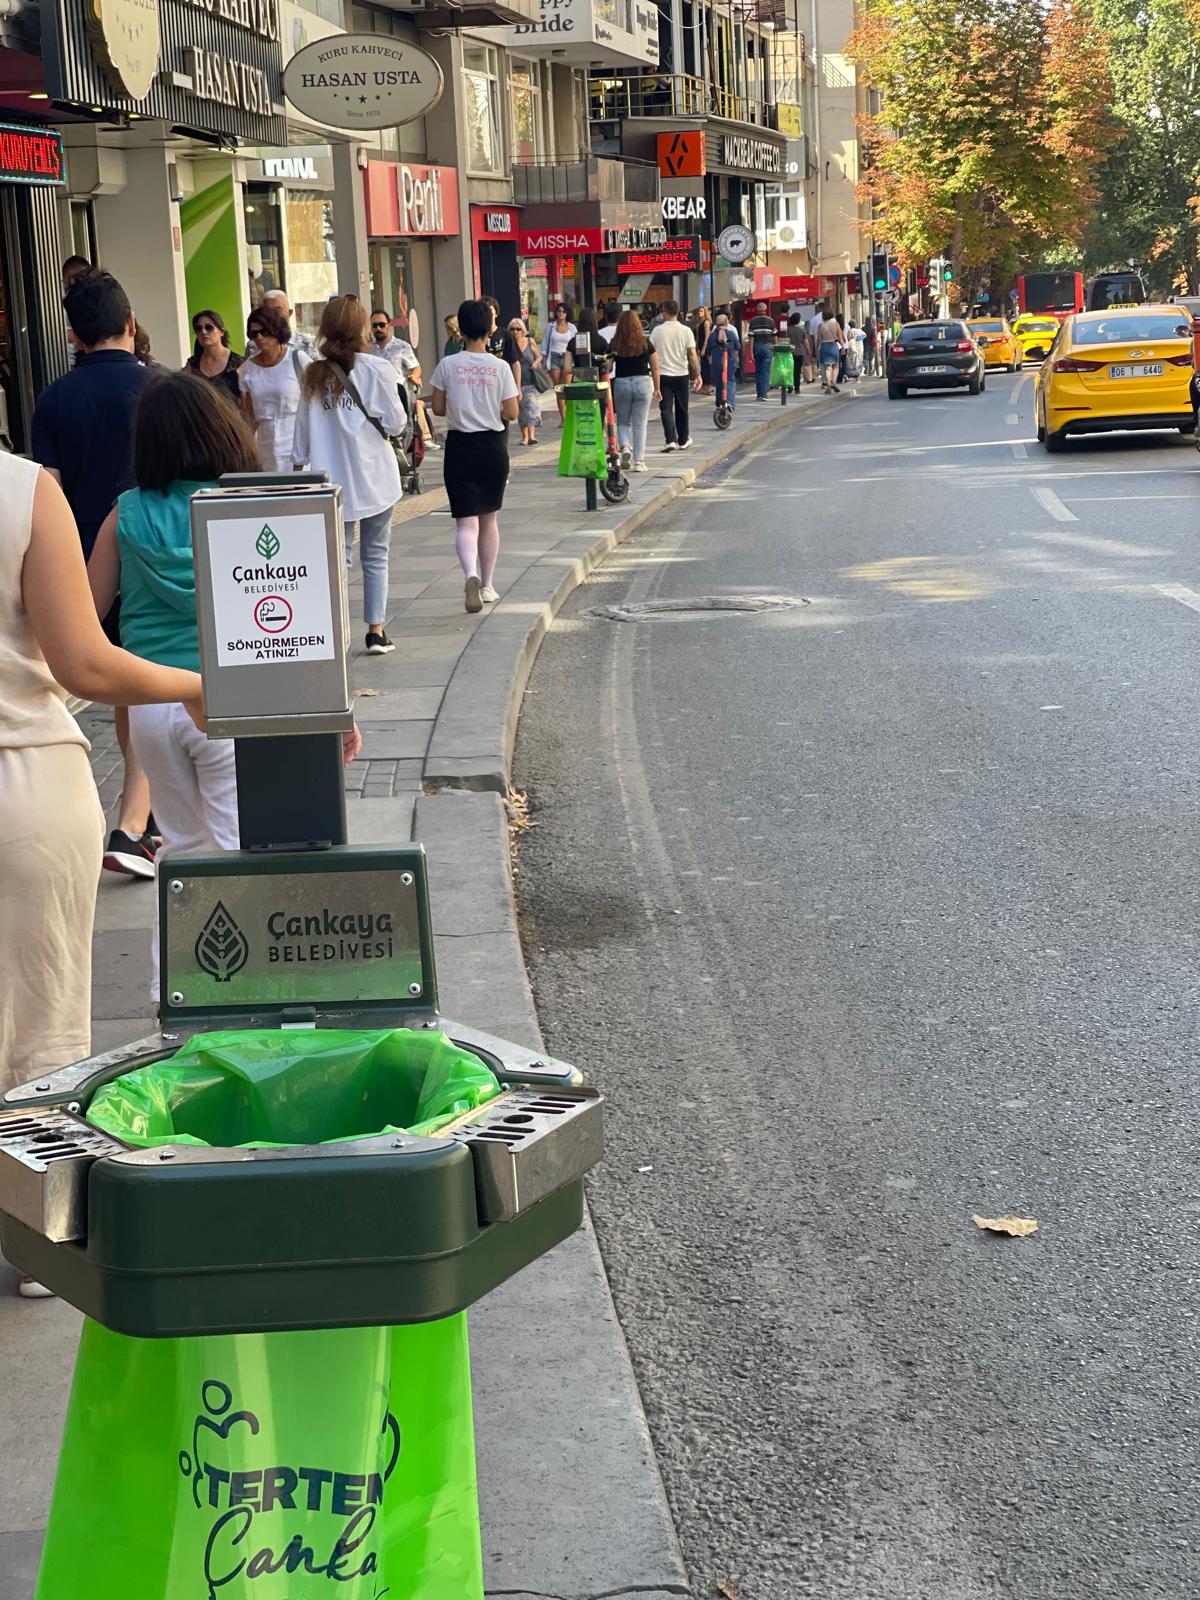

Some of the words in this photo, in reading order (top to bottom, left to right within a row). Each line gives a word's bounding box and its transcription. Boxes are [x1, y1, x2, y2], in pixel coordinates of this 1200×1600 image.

[318, 46, 349, 63] KURU
[193, 45, 241, 109] HASAN
[241, 62, 272, 117] USTA
[302, 72, 367, 88] HASAN
[373, 70, 422, 86] USTA
[401, 165, 444, 232] Penti
[527, 234, 590, 249] MISSHA
[456, 365, 497, 377] CHOOSE
[1115, 367, 1126, 377] 06
[1143, 365, 1163, 375] 6440
[232, 564, 308, 584] Çankaya
[244, 584, 299, 594] BELEDİYESİ
[227, 635, 325, 651] SÖNDÜRMEDEN
[267, 908, 393, 940] Çankaya
[268, 938, 393, 963] BELEDİYESİ
